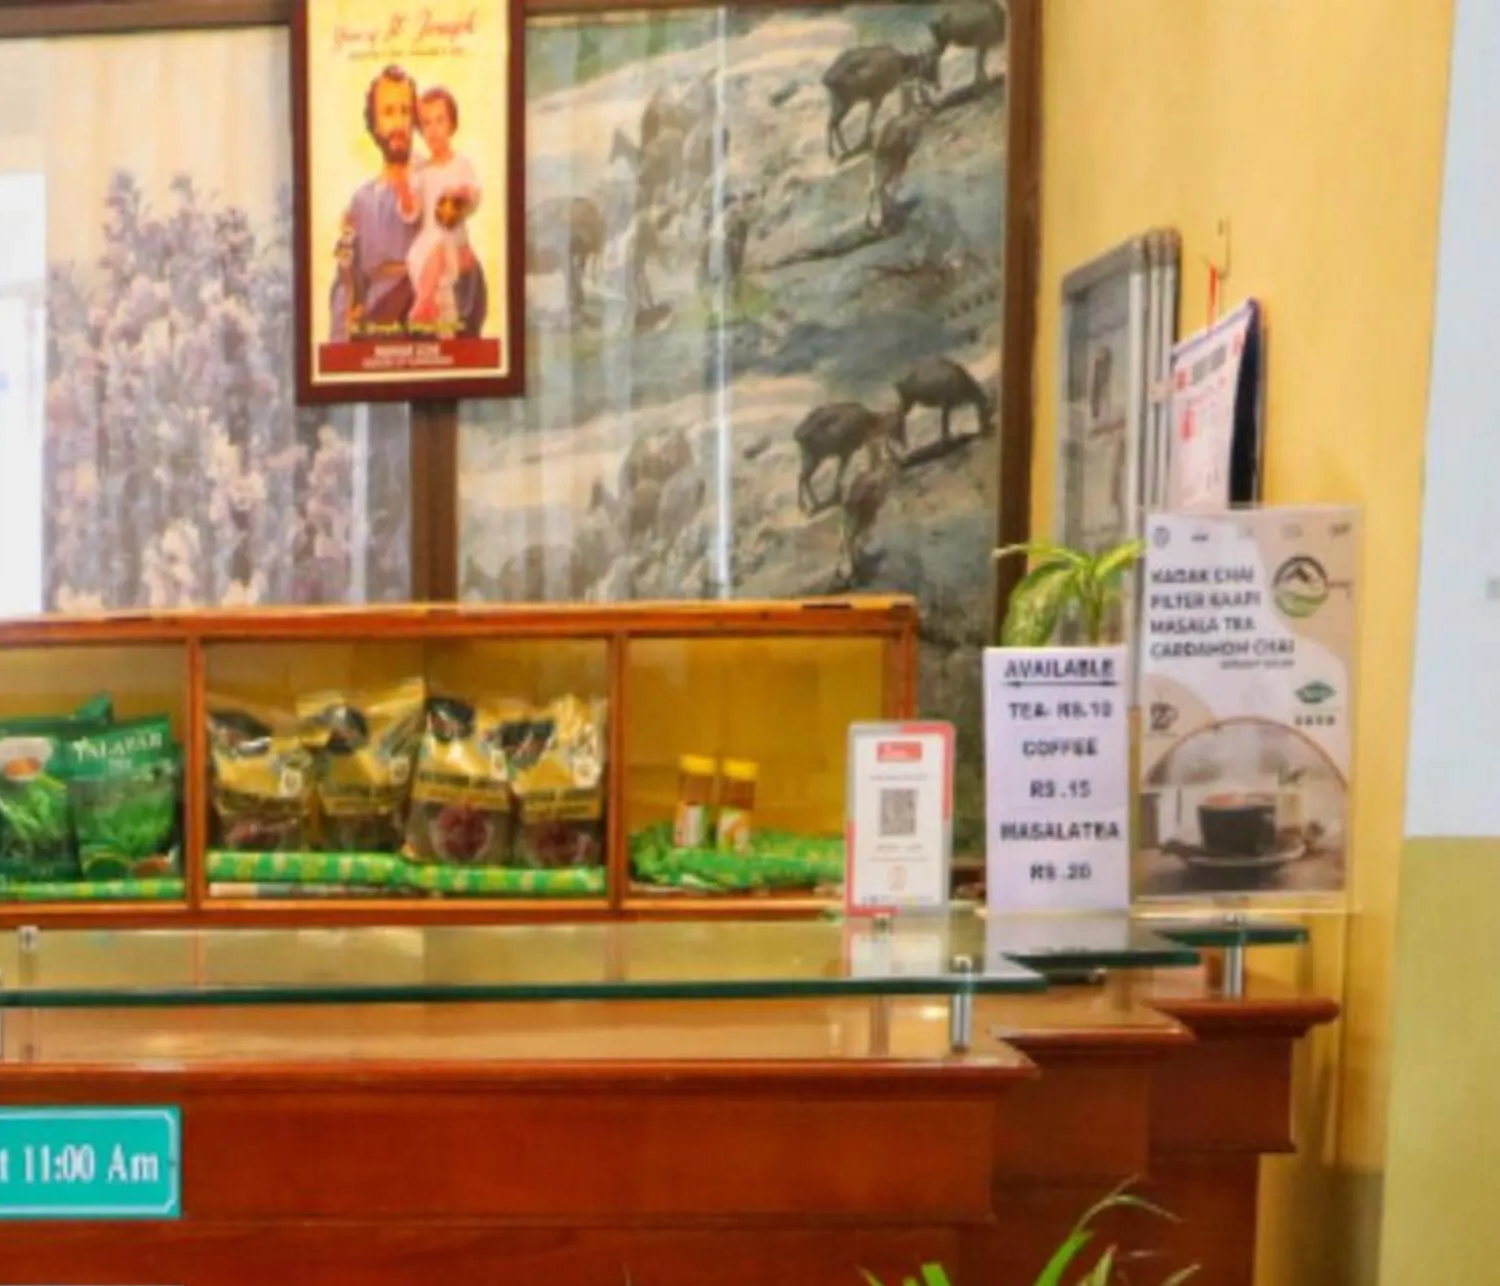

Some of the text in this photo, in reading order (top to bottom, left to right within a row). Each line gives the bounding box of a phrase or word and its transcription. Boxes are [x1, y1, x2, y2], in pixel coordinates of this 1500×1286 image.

[1004, 658, 1115, 679] AVAILABLE
[1021, 738, 1099, 757] COFFEE
[23, 1144, 96, 1183] 11:00
[104, 1143, 160, 1184] Am
